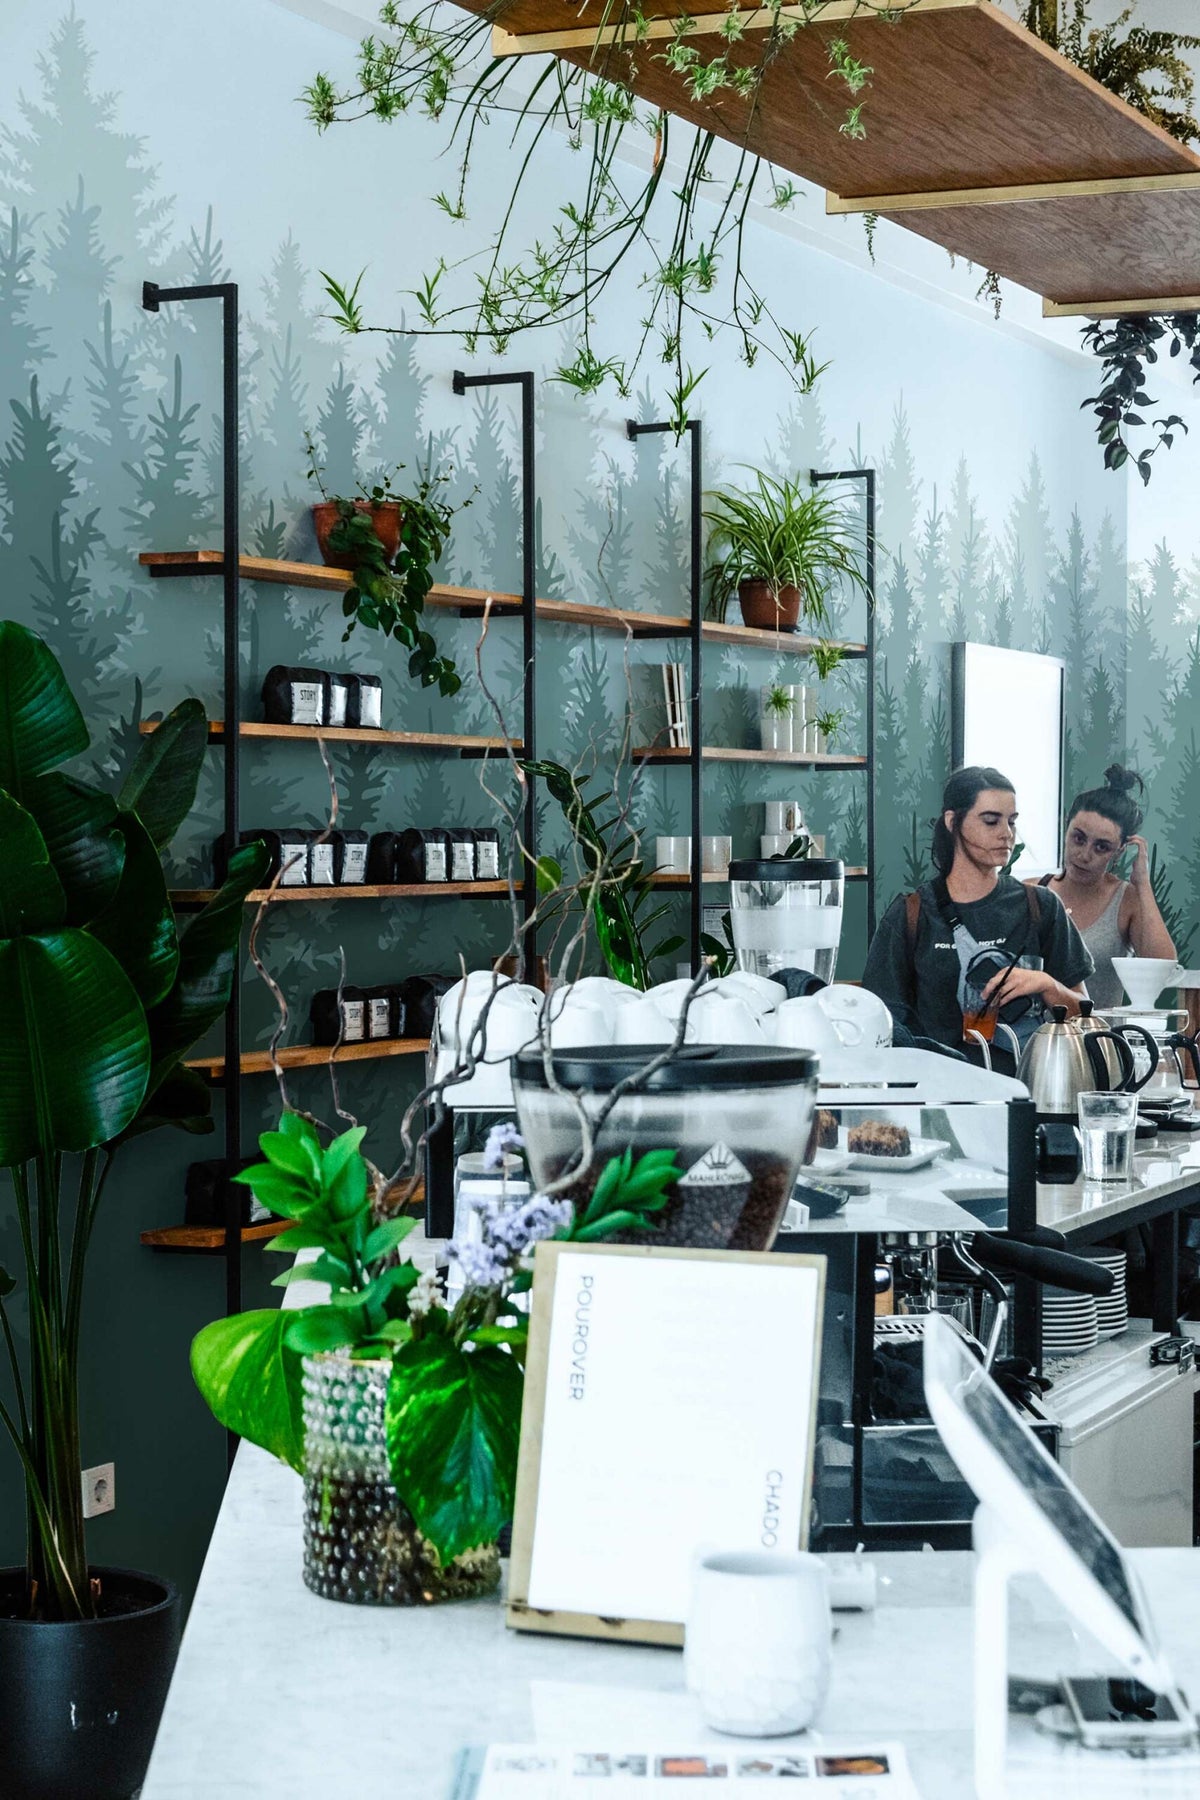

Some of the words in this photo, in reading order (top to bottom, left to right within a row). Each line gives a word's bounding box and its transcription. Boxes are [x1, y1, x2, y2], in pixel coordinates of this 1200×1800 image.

[300, 689, 317, 701] STORY
[568, 1274, 595, 1402] POUROVER
[760, 1469, 783, 1548] CHADO
